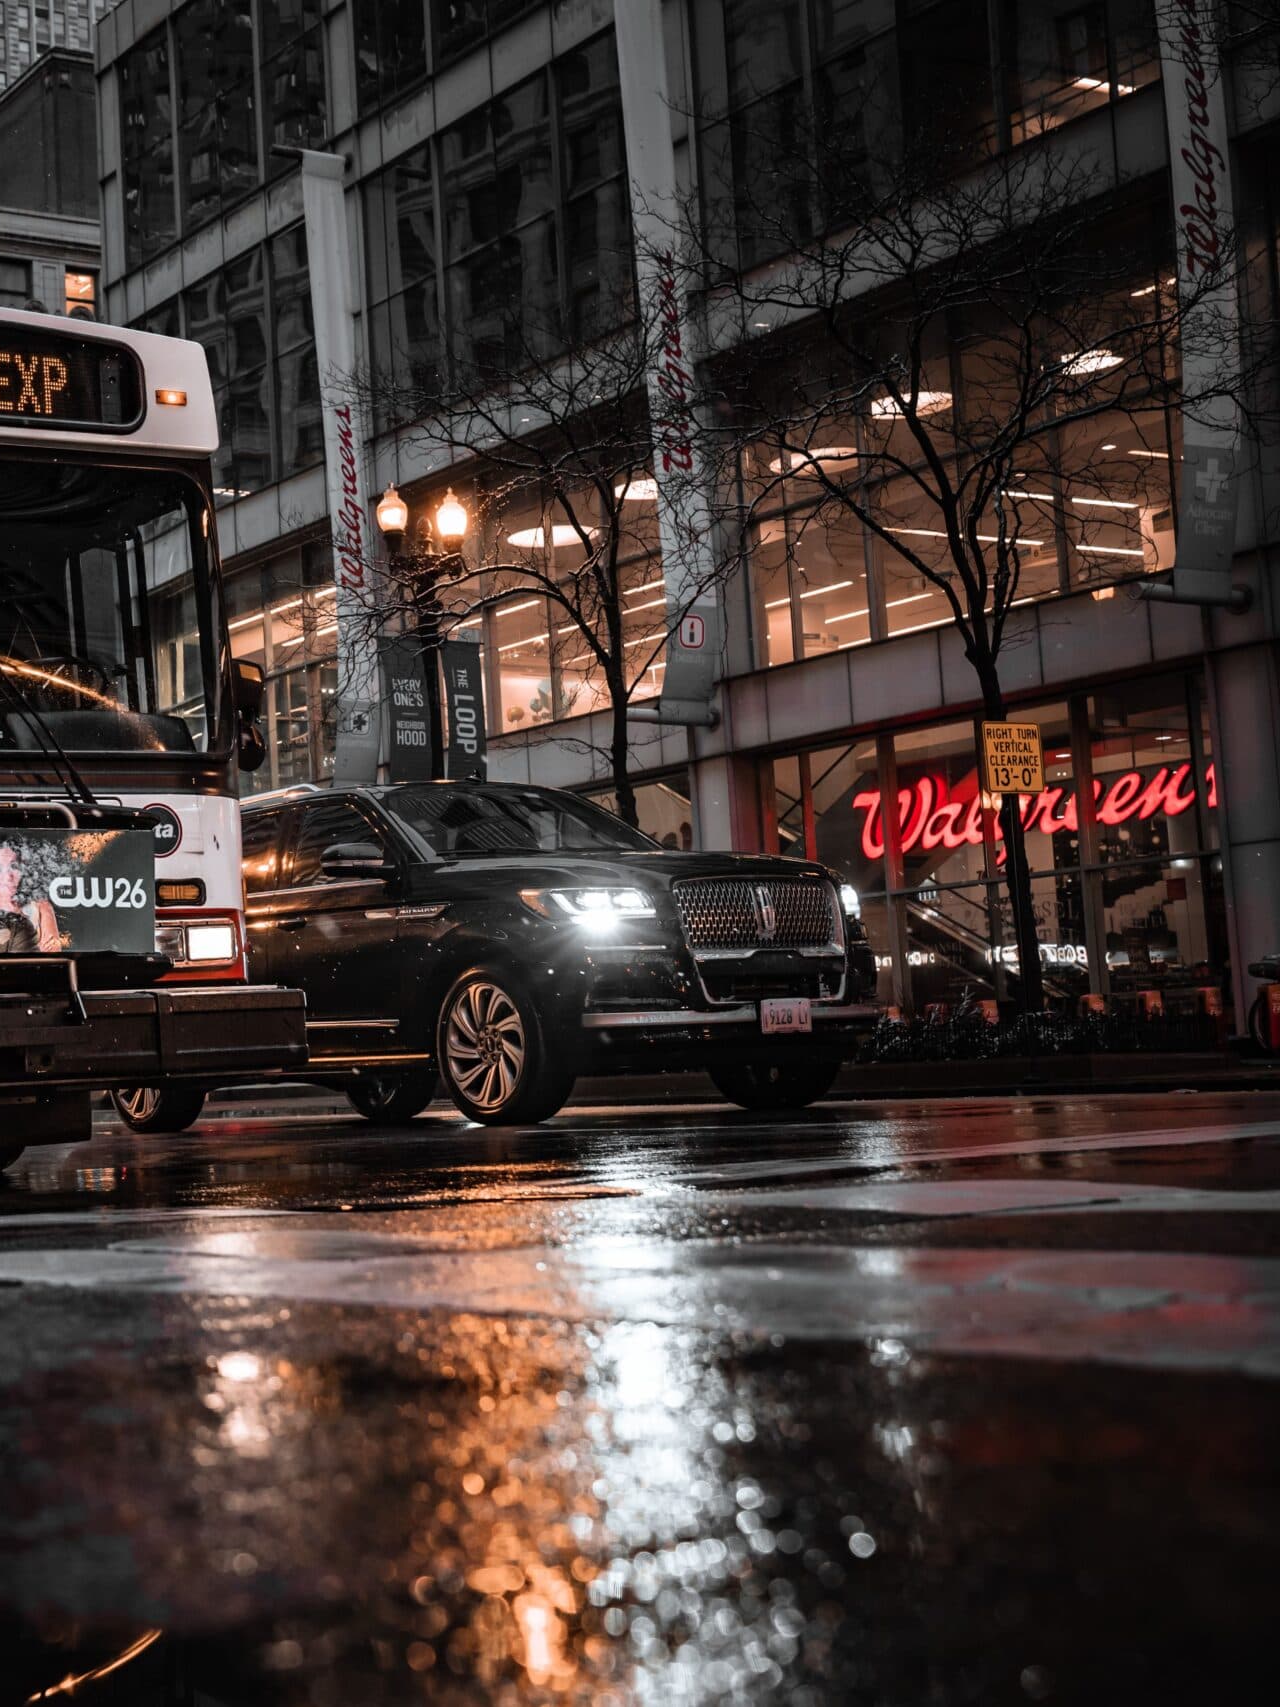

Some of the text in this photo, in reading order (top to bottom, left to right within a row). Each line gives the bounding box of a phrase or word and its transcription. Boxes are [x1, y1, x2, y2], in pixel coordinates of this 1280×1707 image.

[334, 405, 367, 589] Walgreens
[393, 692, 424, 707] ONE'S
[453, 668, 477, 754] THE LOOP
[396, 720, 426, 730] NEIGHBOR
[396, 730, 427, 746] HOOD
[986, 728, 1037, 740] RIGHT TURN
[993, 741, 1033, 753] VERTICAL
[989, 755, 1039, 767] CLEARANCE
[994, 767, 1037, 787] 13'-0"
[153, 823, 174, 838] ta
[770, 1008, 793, 1025] 9128
